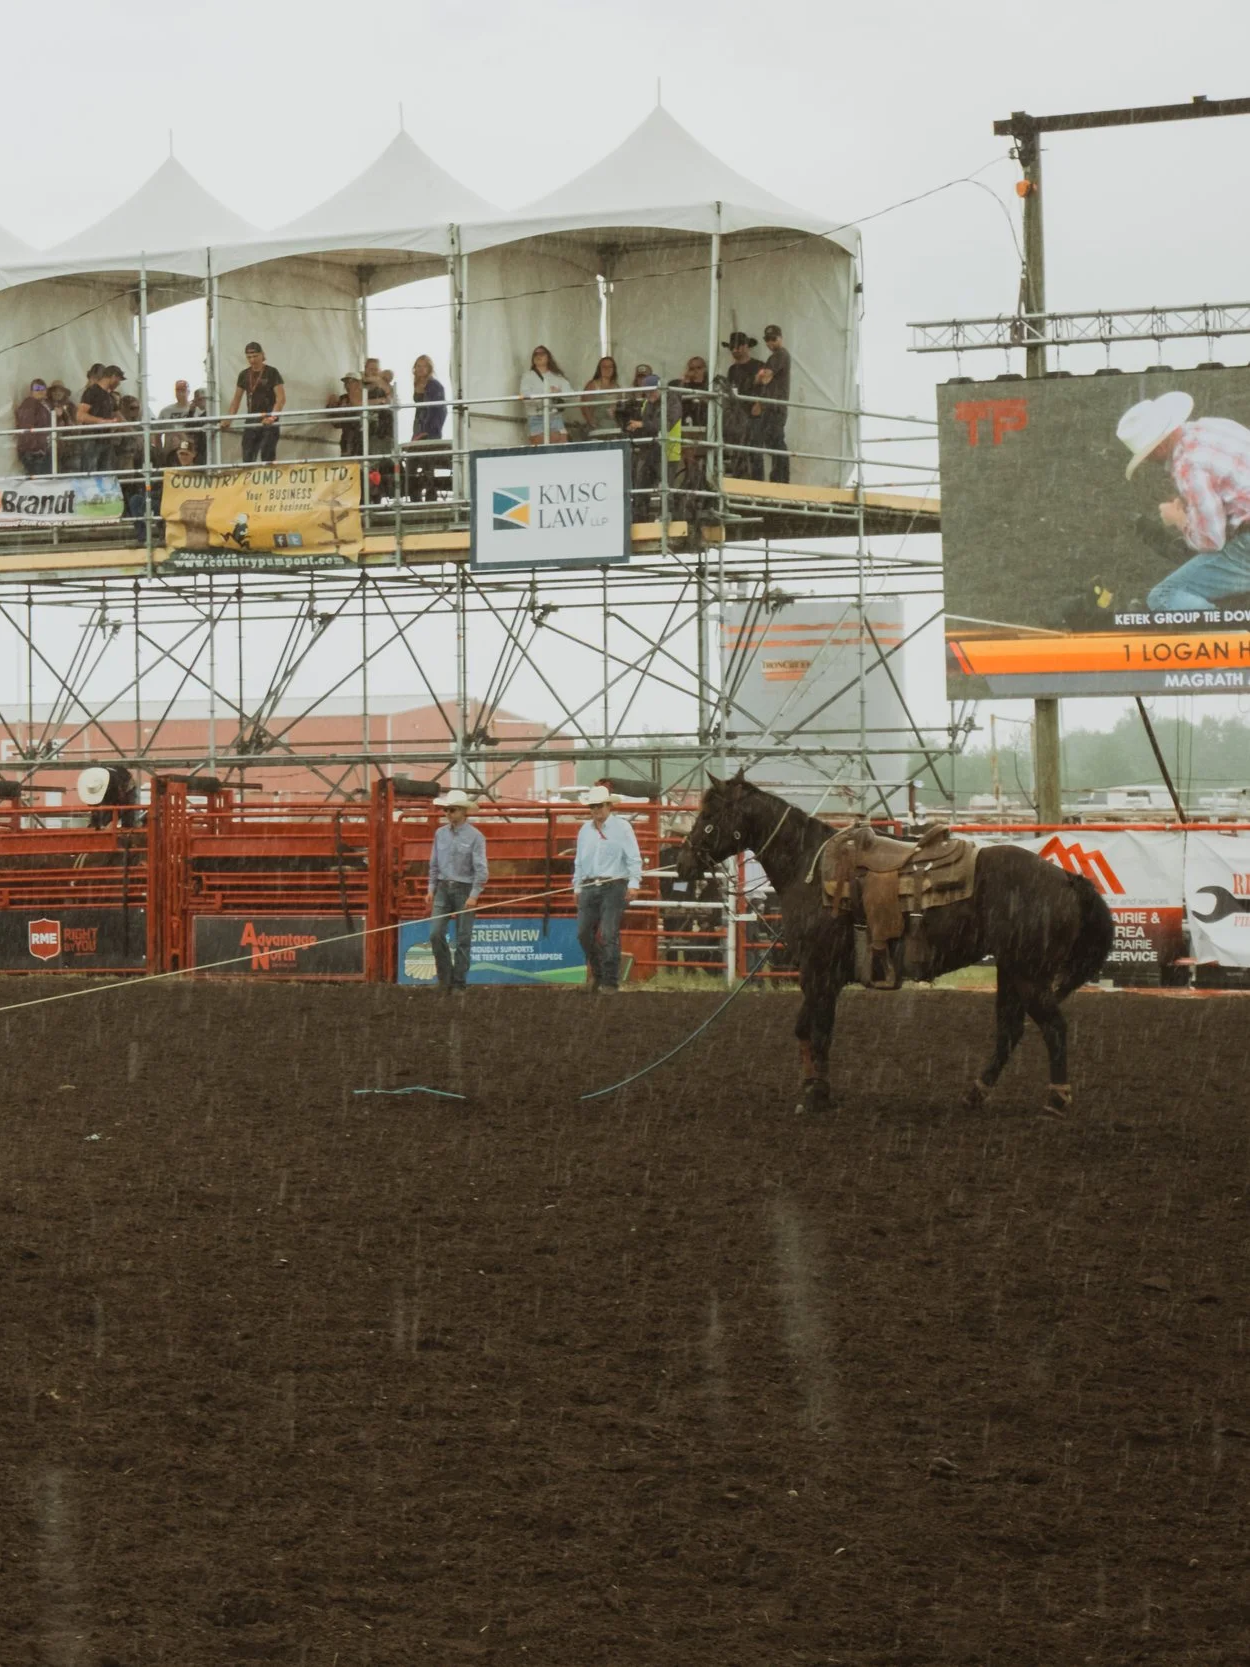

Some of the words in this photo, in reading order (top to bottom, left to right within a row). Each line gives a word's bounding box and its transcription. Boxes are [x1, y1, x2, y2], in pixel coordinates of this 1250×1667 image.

[955, 400, 1027, 446] TP
[171, 473, 240, 489] COUNTRY
[243, 469, 284, 486] PUMP
[290, 468, 316, 484] OUT
[324, 466, 354, 482] LTD.
[246, 490, 263, 501] Your
[538, 482, 608, 504] KMSC
[1, 490, 76, 514] Brandt
[254, 503, 261, 512] is
[264, 504, 277, 512] our
[538, 507, 589, 529] LAW
[591, 517, 609, 526] LLP
[1115, 613, 1151, 625] KETEK
[1154, 611, 1200, 624] GROUP
[1204, 610, 1221, 623] TIE
[1124, 644, 1130, 662] 1
[1142, 642, 1229, 661] LOGAN
[1165, 671, 1244, 687] MAGRATH
[1151, 911, 1161, 924] &
[31, 932, 58, 945] RME
[63, 927, 98, 940] RIGHT
[240, 922, 318, 950] Advantage
[470, 929, 540, 942] GREENVIEW
[1114, 926, 1146, 938] REA
[500, 945, 534, 953] SUPPORTS
[252, 946, 296, 970] North
